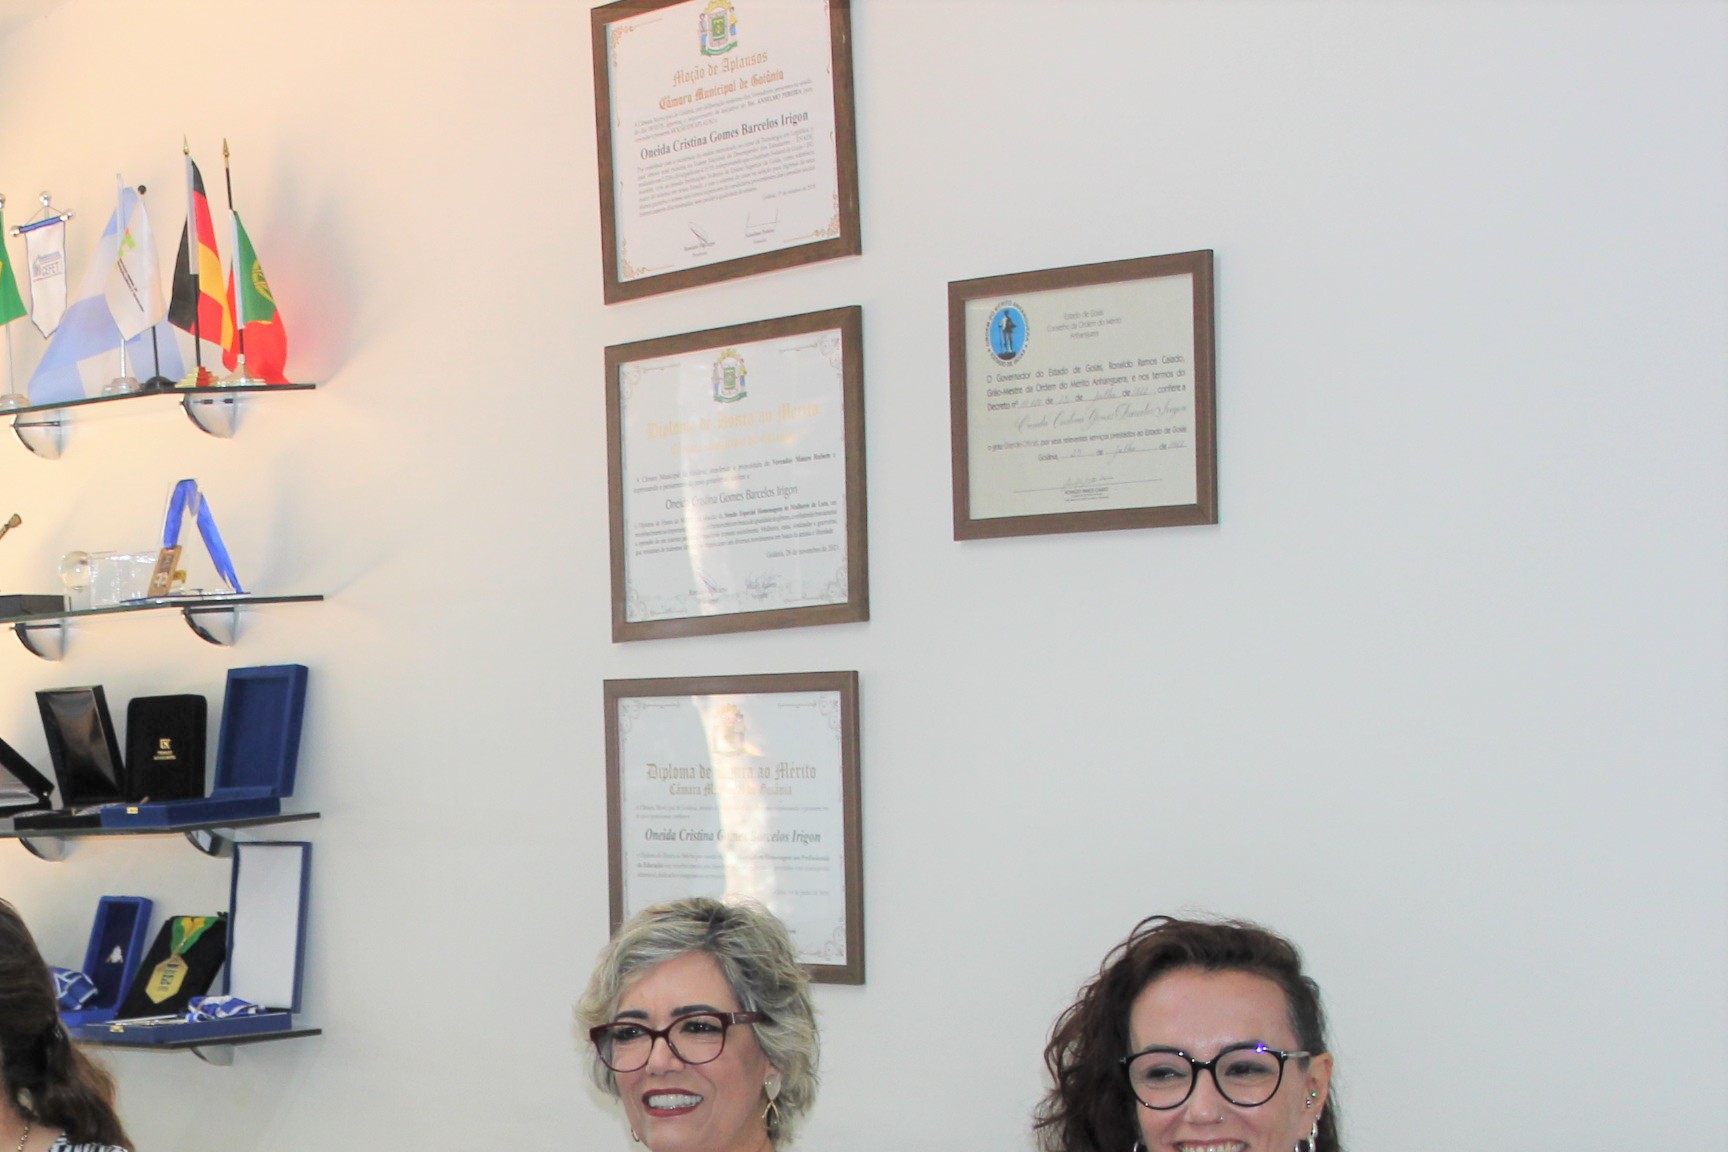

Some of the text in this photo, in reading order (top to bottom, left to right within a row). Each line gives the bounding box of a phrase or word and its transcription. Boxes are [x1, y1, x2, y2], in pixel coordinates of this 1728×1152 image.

[672, 49, 767, 85] Moção de Aplausos
[658, 92, 691, 110] Câmara
[694, 78, 735, 100] Municipal
[739, 76, 747, 89] de
[750, 67, 784, 87] Goiânia
[640, 111, 808, 160] Oneida Cristina Gomes Barcelos Irigon
[1082, 310, 1089, 318] de
[986, 374, 992, 383] O
[996, 371, 1030, 382] Governador
[1035, 370, 1043, 378] do
[1048, 366, 1068, 376] Estado
[1072, 365, 1080, 373] de
[1108, 359, 1133, 370] Ronaldo
[986, 386, 1022, 397] Grão-Mestre
[1025, 385, 1033, 393] da
[1035, 383, 1056, 392] Ordem
[1058, 381, 1067, 389] do
[1176, 369, 1185, 377] do
[987, 401, 1009, 411] Decreto
[1074, 394, 1082, 402] de
[1122, 389, 1130, 397] de
[1144, 428, 1161, 436] Estado
[1159, 442, 1166, 450] de
[719, 492, 744, 503] Gomes
[745, 486, 774, 500] Barcelos
[776, 484, 797, 499] Irigon
[646, 762, 695, 781] Diploma
[698, 762, 712, 778] de
[757, 766, 770, 778] ao
[774, 760, 816, 779] Mérito
[645, 828, 676, 840] Oneida
[679, 828, 714, 841] Cristina
[792, 829, 820, 844] Irigon
